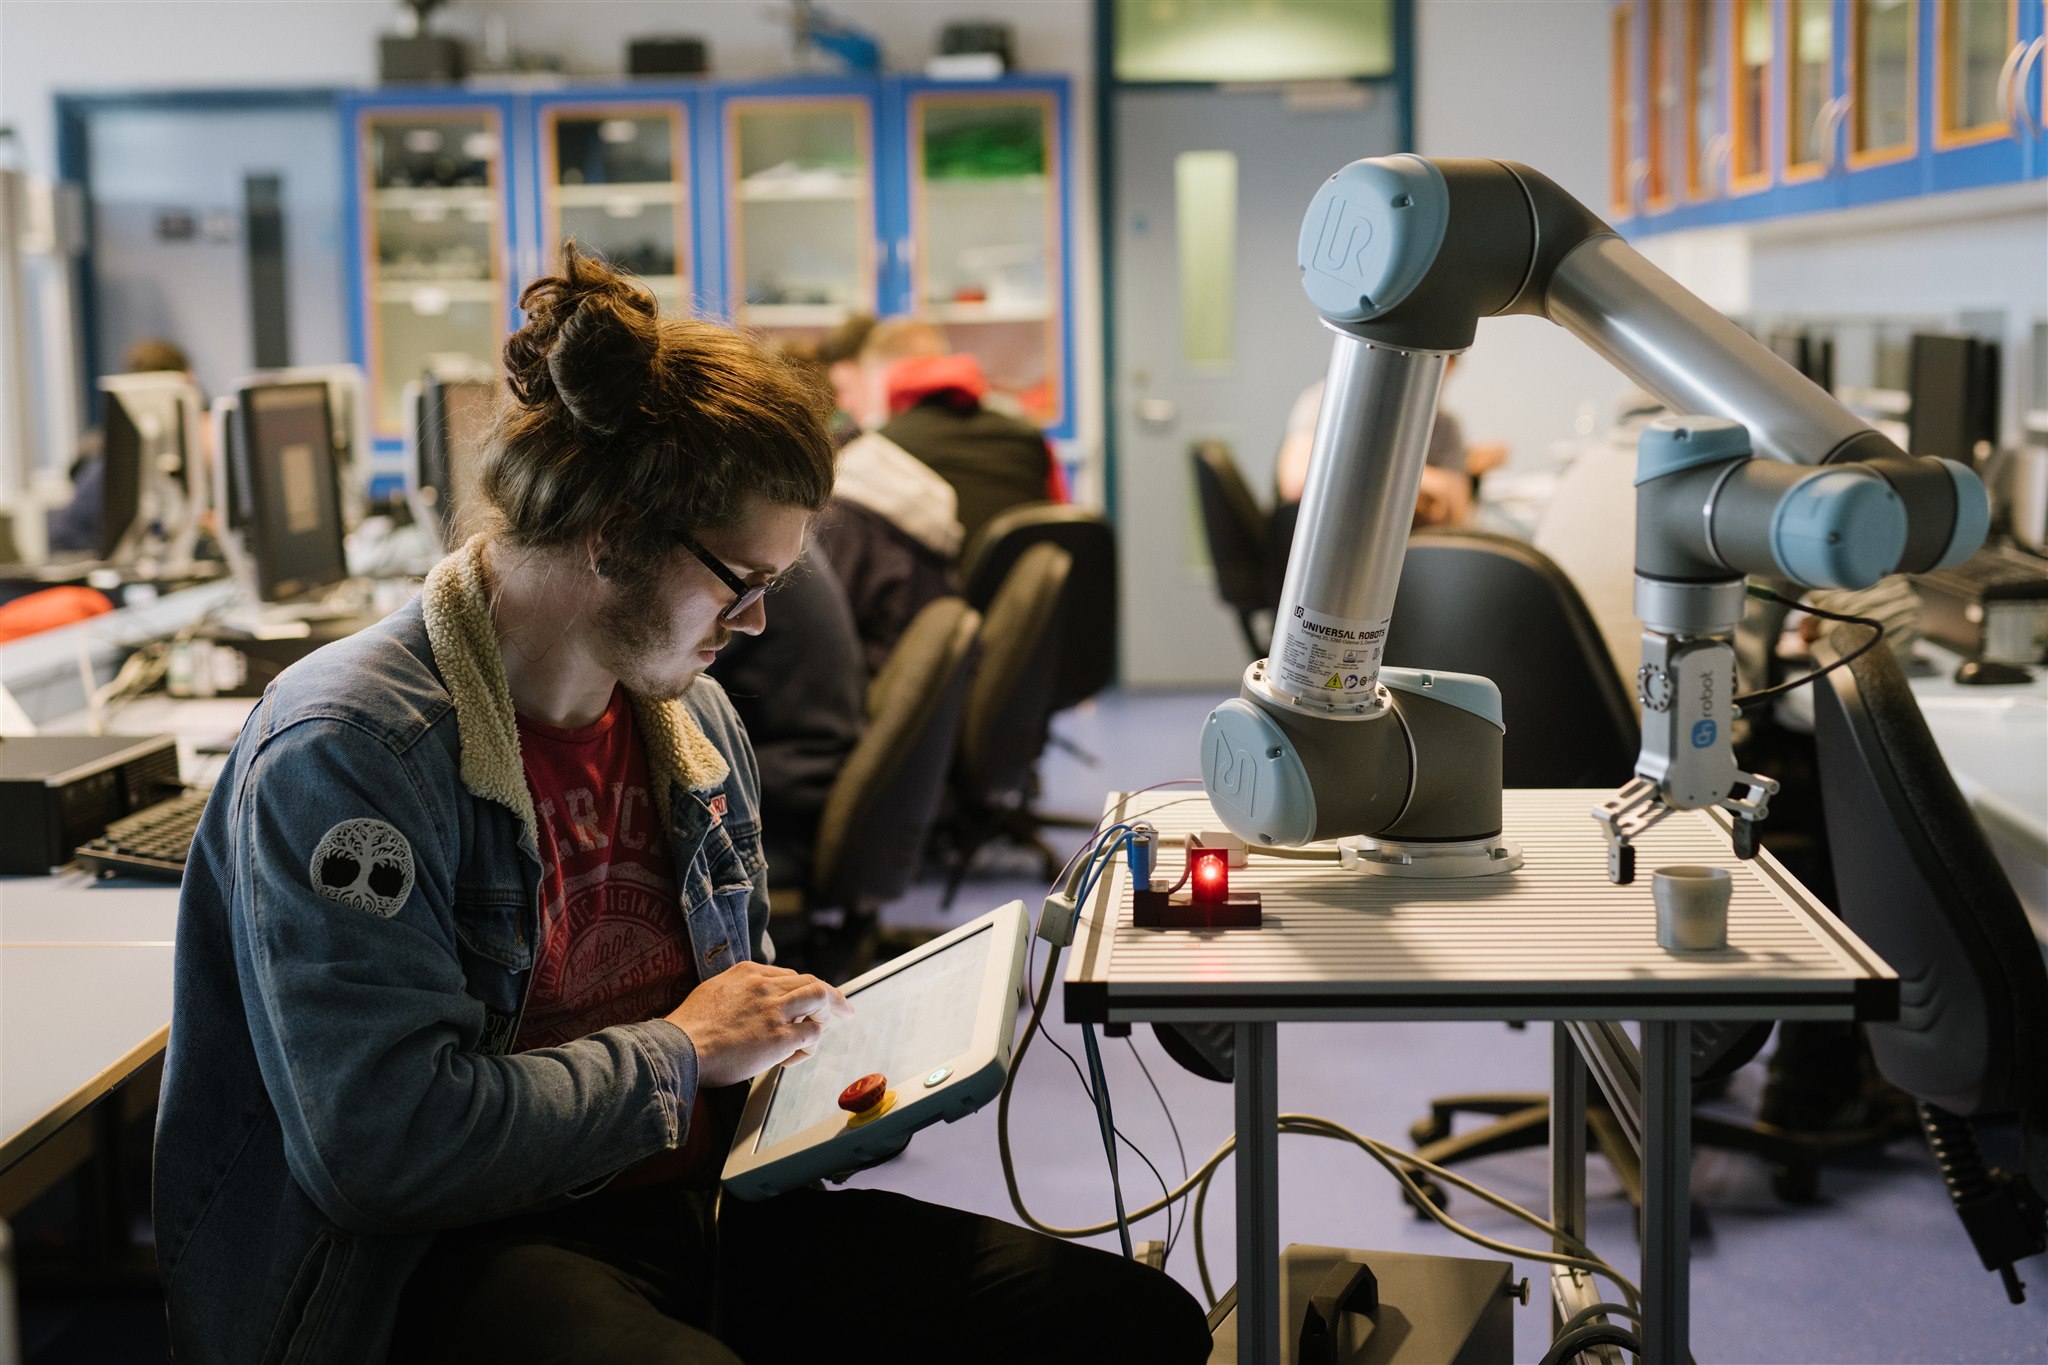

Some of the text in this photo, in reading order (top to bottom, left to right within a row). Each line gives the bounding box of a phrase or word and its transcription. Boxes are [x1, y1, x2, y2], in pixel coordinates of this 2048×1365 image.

[1302, 620, 1385, 639] UNIVERSAL ROBOTS
[1699, 669, 1713, 717] robot
